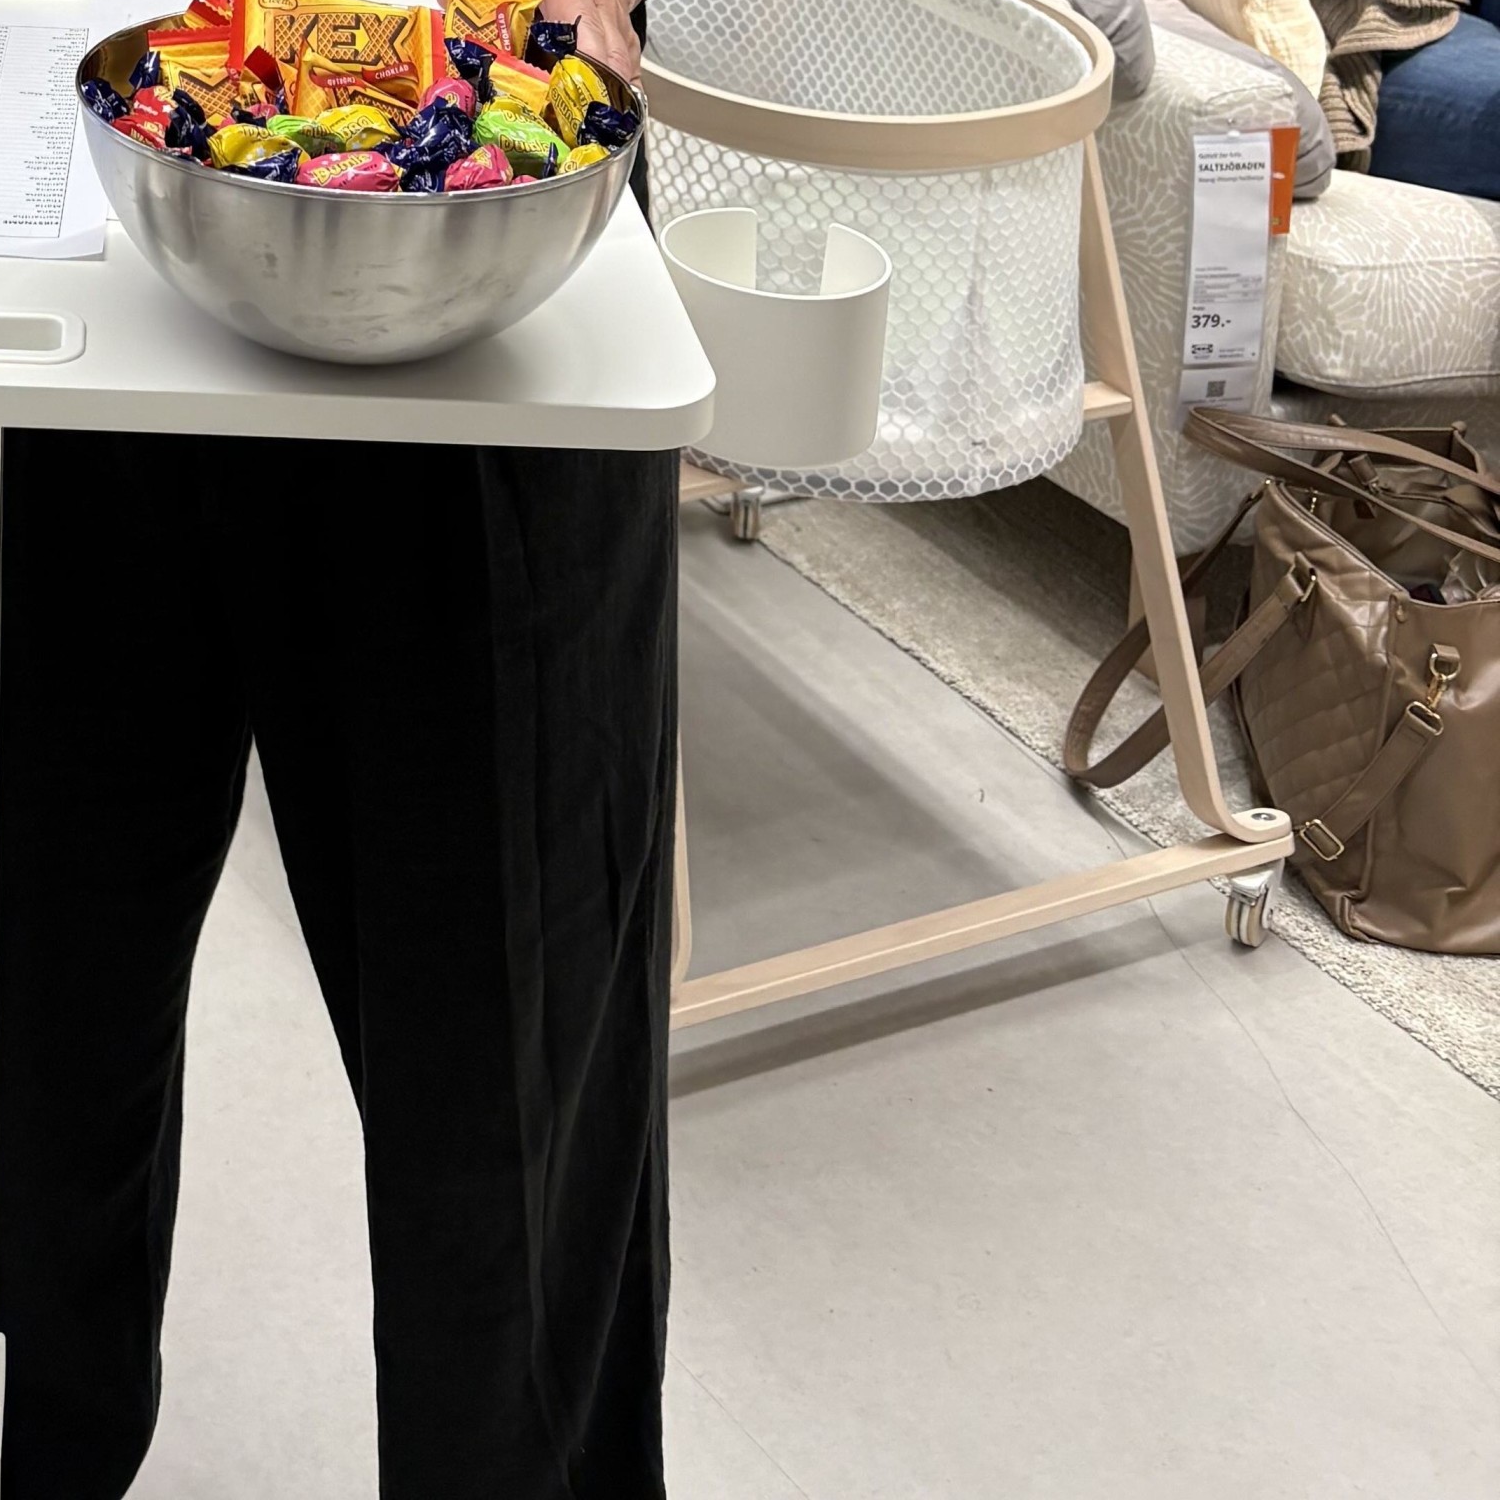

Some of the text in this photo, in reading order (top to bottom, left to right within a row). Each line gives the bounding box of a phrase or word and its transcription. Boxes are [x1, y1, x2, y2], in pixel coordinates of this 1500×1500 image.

[273, 12, 409, 67] KEX
[497, 12, 512, 52] CHOKLAD
[374, 63, 410, 81] CHOKLAD
[311, 153, 373, 187] Dumle
[1198, 161, 1266, 173] SALTSJÖBADEN
[1190, 314, 1232, 329] 379.-
